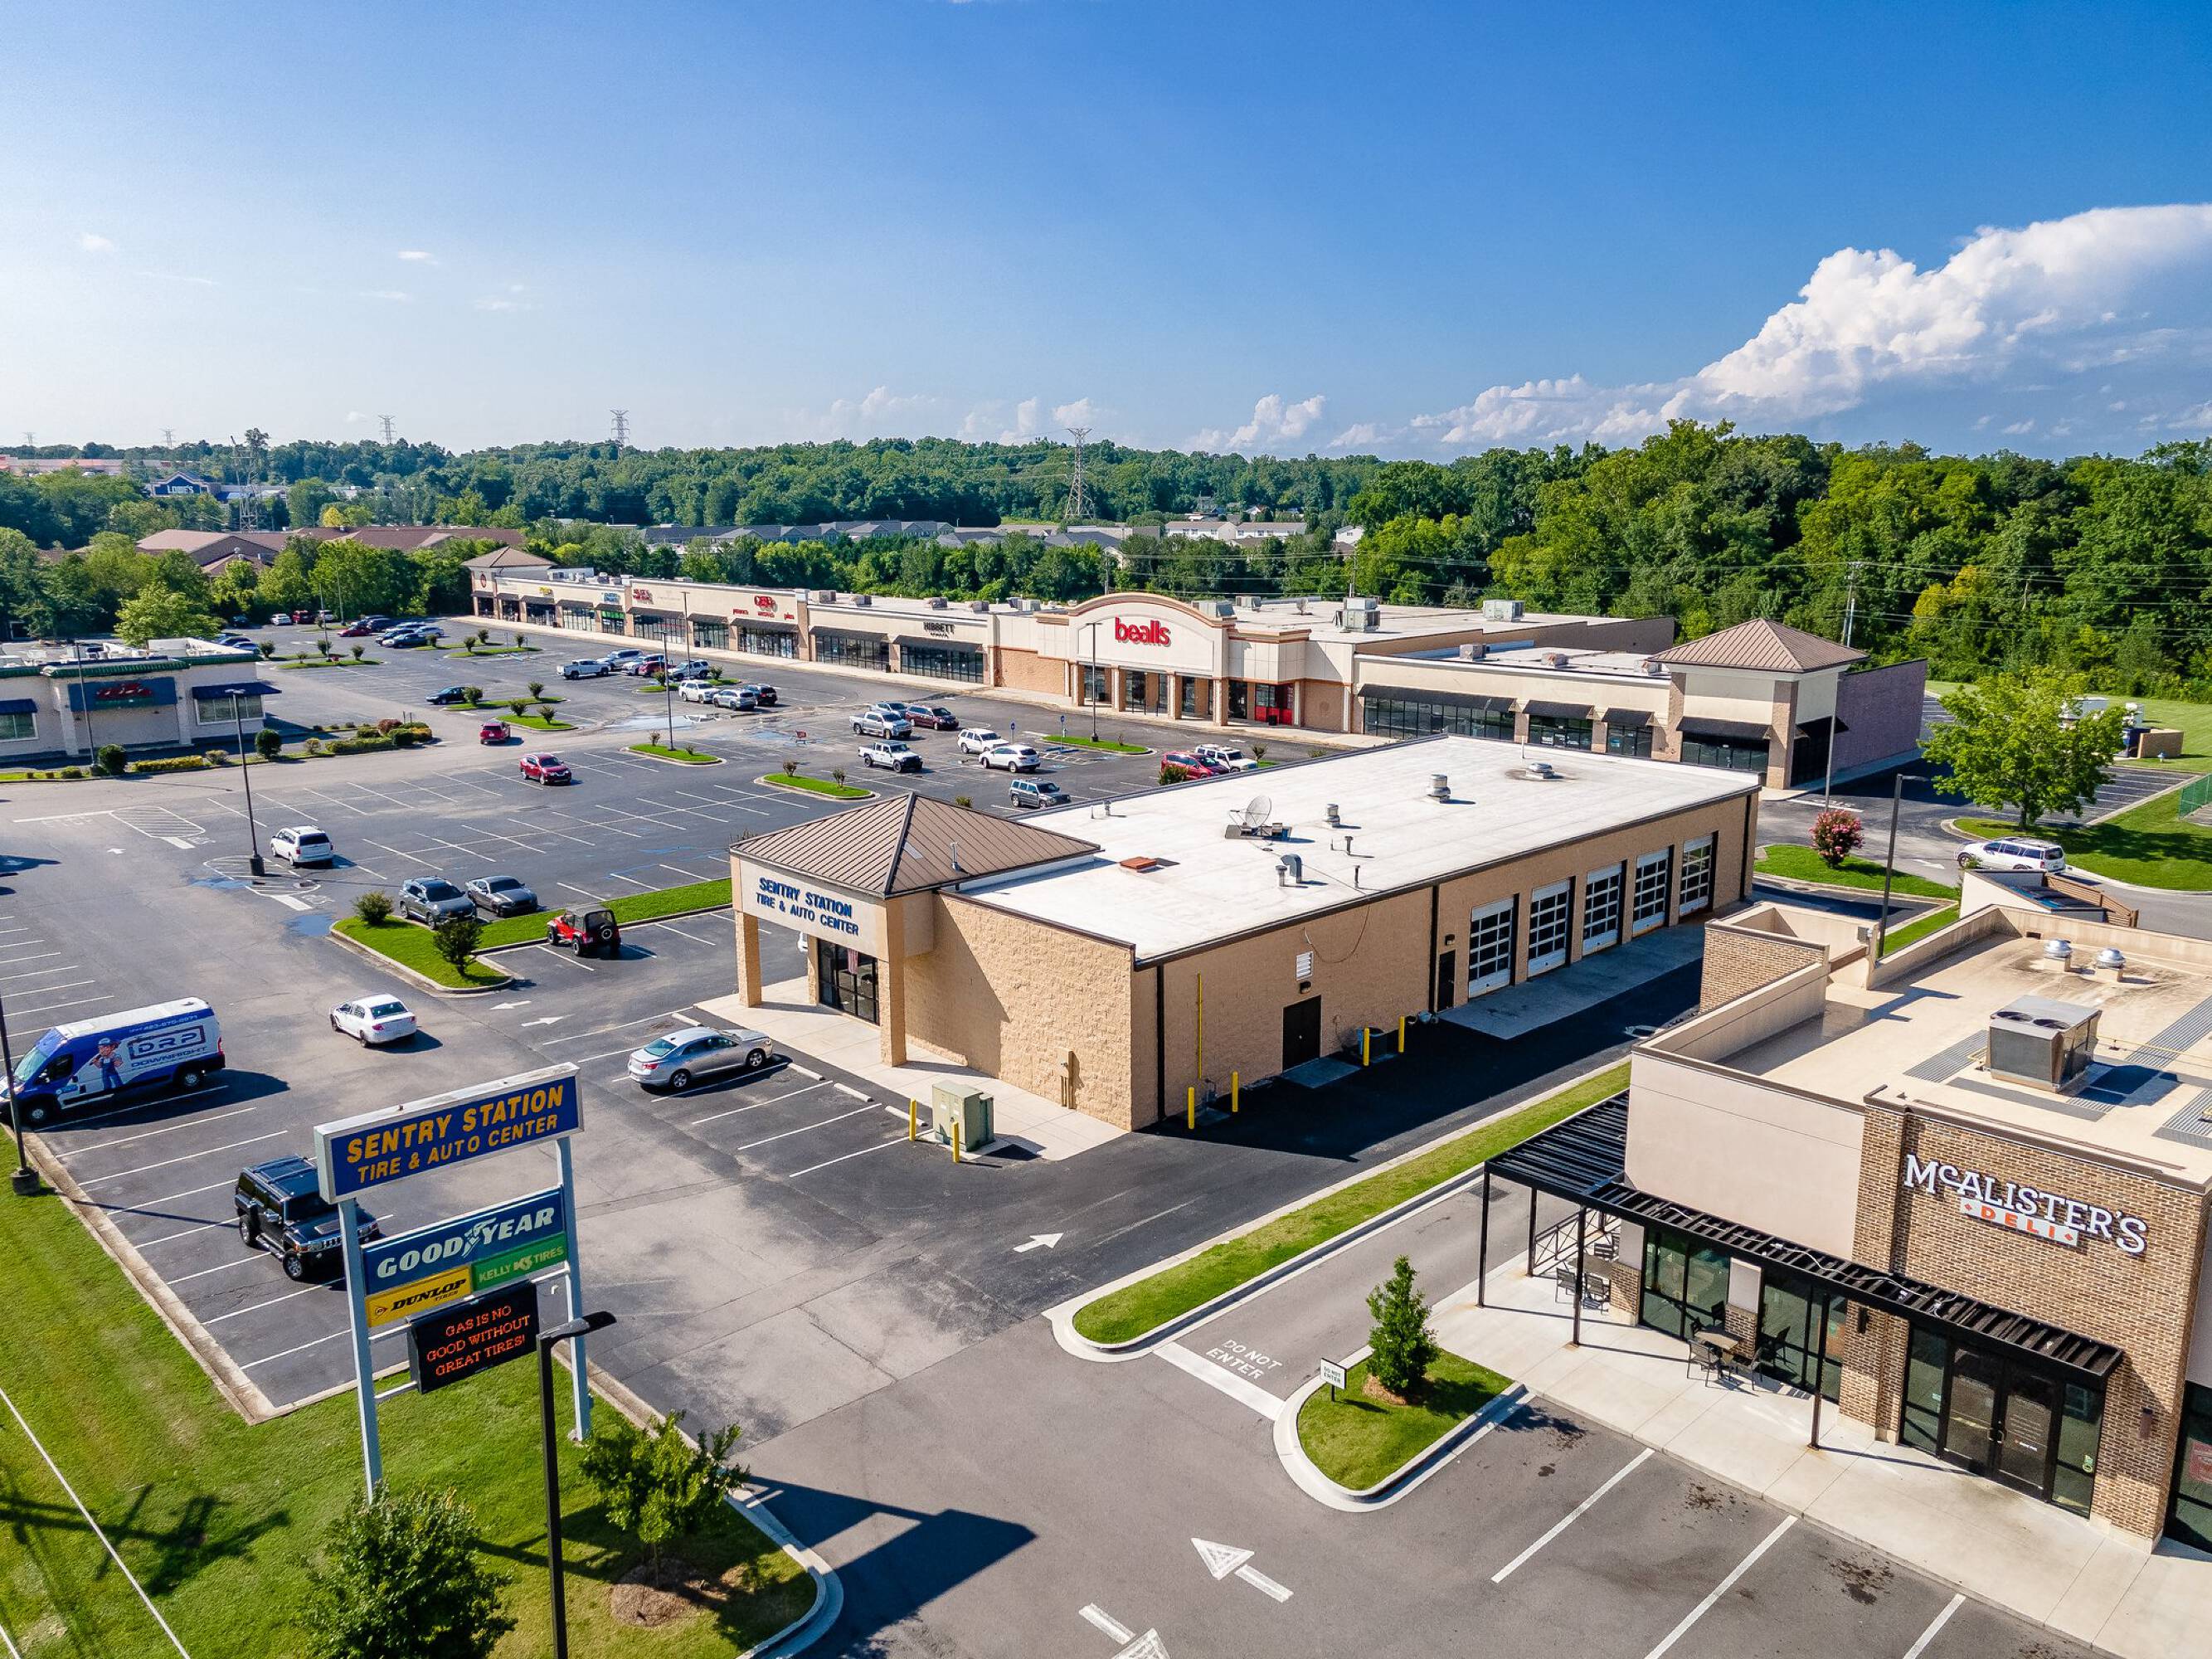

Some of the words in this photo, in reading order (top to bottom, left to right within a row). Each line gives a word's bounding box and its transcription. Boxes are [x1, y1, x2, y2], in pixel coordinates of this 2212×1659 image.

[168, 484, 194, 494] LOWE'S
[1115, 616, 1171, 645] bealls
[756, 893, 775, 909] TIRE
[780, 900, 786, 912] &
[790, 904, 815, 922] AUTO
[820, 913, 858, 937] CENTER
[760, 877, 800, 902] SENTRY
[805, 892, 853, 919] STATION
[347, 1114, 452, 1164] SENTRY
[462, 1084, 563, 1132] STATION
[357, 1160, 401, 1184] TIRE
[408, 1152, 421, 1170] &
[427, 1136, 480, 1163] AUTO
[489, 1114, 558, 1147] CENTER
[1981, 1205, 2055, 1240] DELI
[377, 1208, 555, 1278] GOODYEAR
[479, 1262, 512, 1282] KELLY
[532, 1246, 564, 1263] TIRES
[391, 1278, 467, 1311] DUNLOP
[426, 1339, 466, 1362] GOOD
[468, 1315, 531, 1345] WITHOUT
[445, 1318, 474, 1337] GAS
[476, 1311, 489, 1326] IS
[491, 1305, 512, 1321] NO
[435, 1351, 481, 1376] GREAT
[484, 1334, 526, 1358] TIRES!
[1206, 1348, 1265, 1380] ENTER
[1223, 1340, 1246, 1354] DO
[1247, 1349, 1283, 1370] NOT
